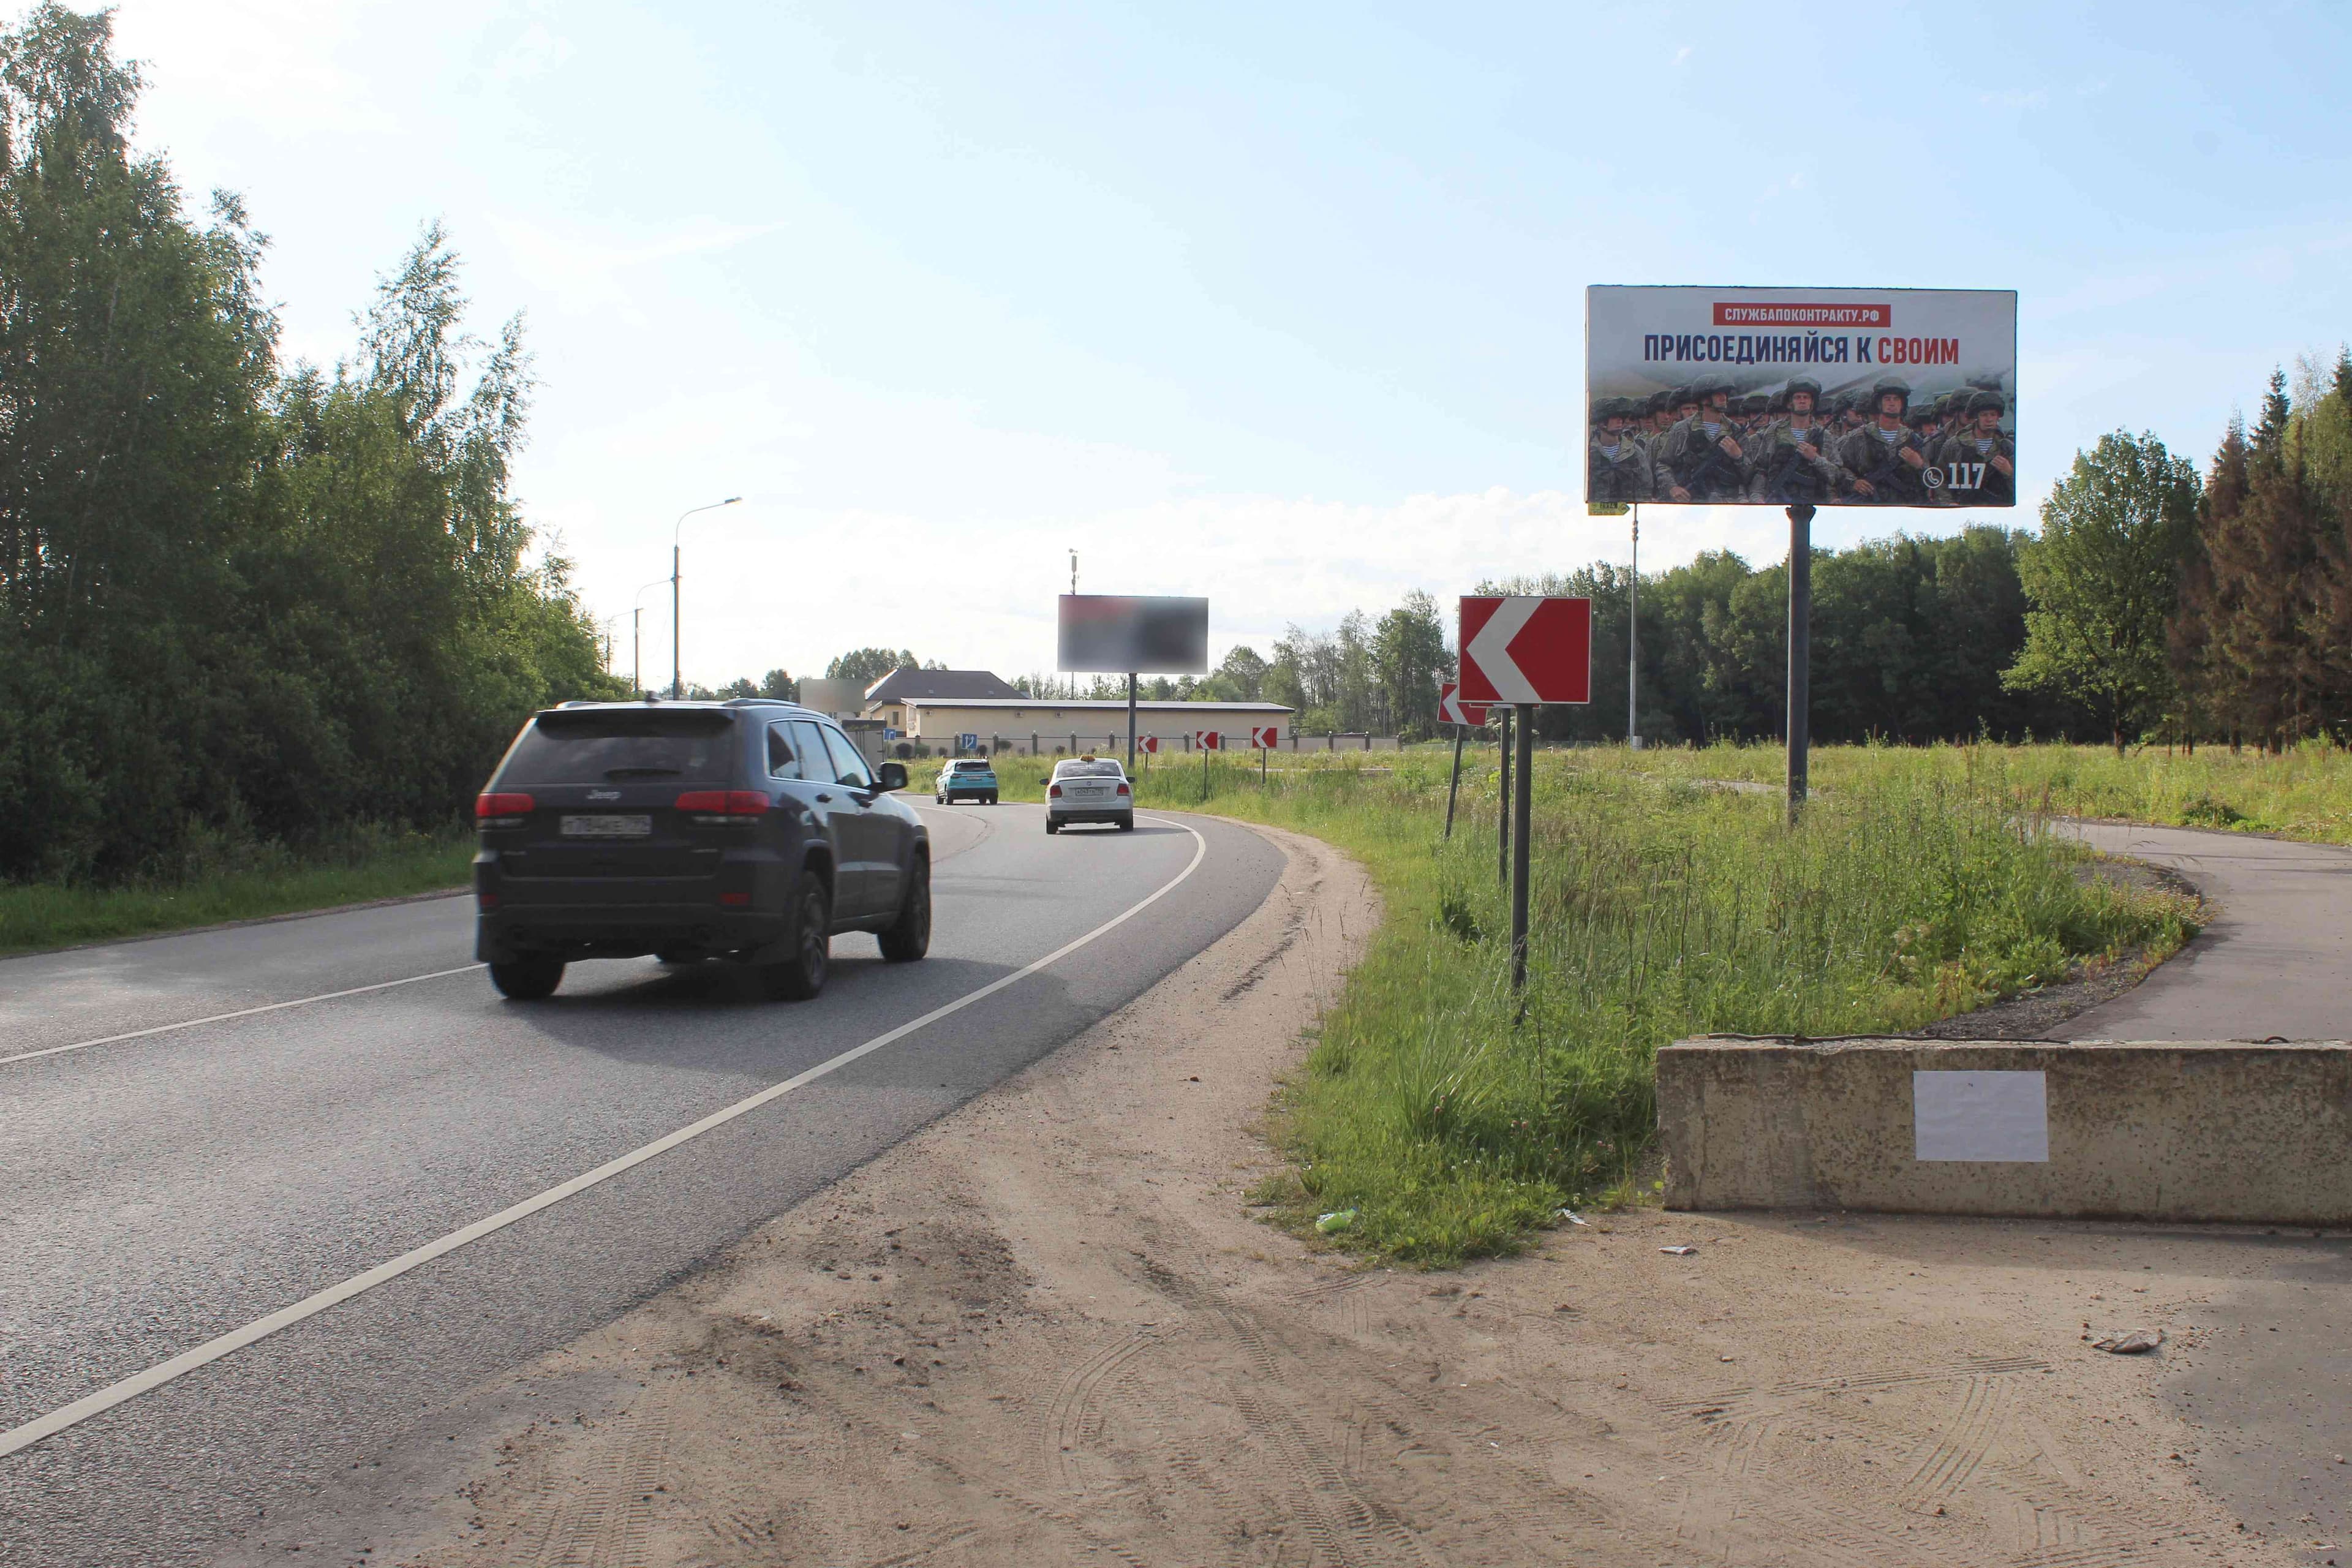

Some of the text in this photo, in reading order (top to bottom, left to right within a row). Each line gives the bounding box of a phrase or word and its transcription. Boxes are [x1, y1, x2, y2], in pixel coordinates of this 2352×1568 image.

[1725, 307, 1880, 322] СЛУЖБАПОКОНТРАКТУ.РФ
[1645, 330, 1959, 364] ПРИСОЕДИНЯЙСЯ К СВОИМ
[1948, 462, 1986, 489] 117
[586, 790, 622, 801] Jeep
